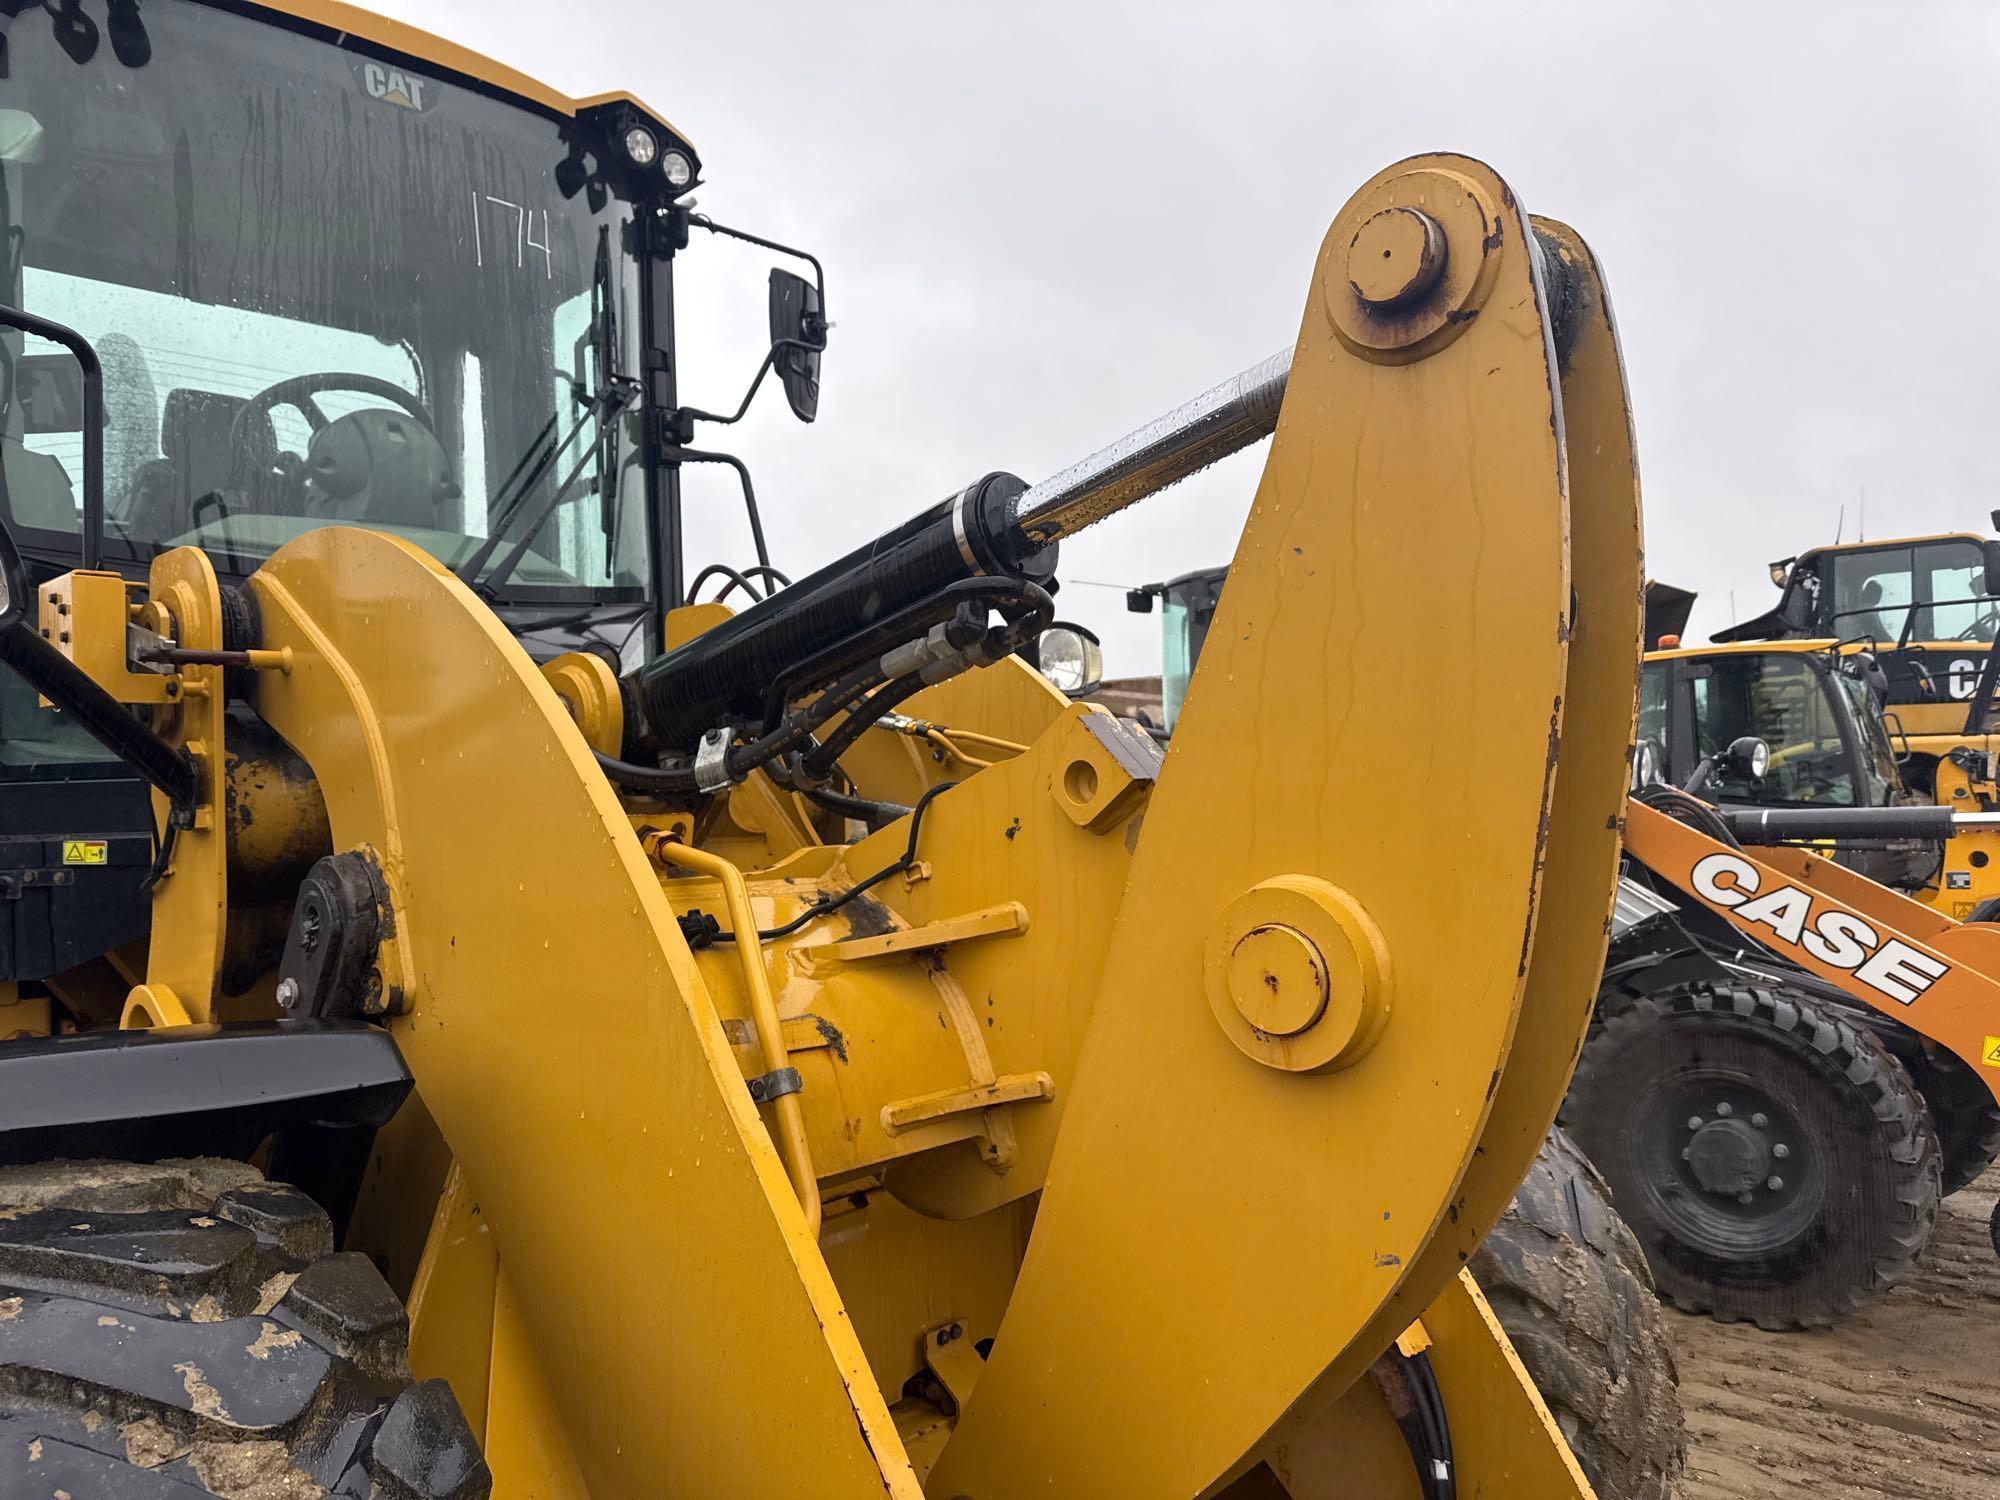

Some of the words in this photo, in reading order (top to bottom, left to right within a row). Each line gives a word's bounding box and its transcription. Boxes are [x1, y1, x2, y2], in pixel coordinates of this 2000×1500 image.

[364, 63, 424, 111] CAT
[472, 191, 551, 279] 174
[1690, 853, 1952, 1006] CASE
